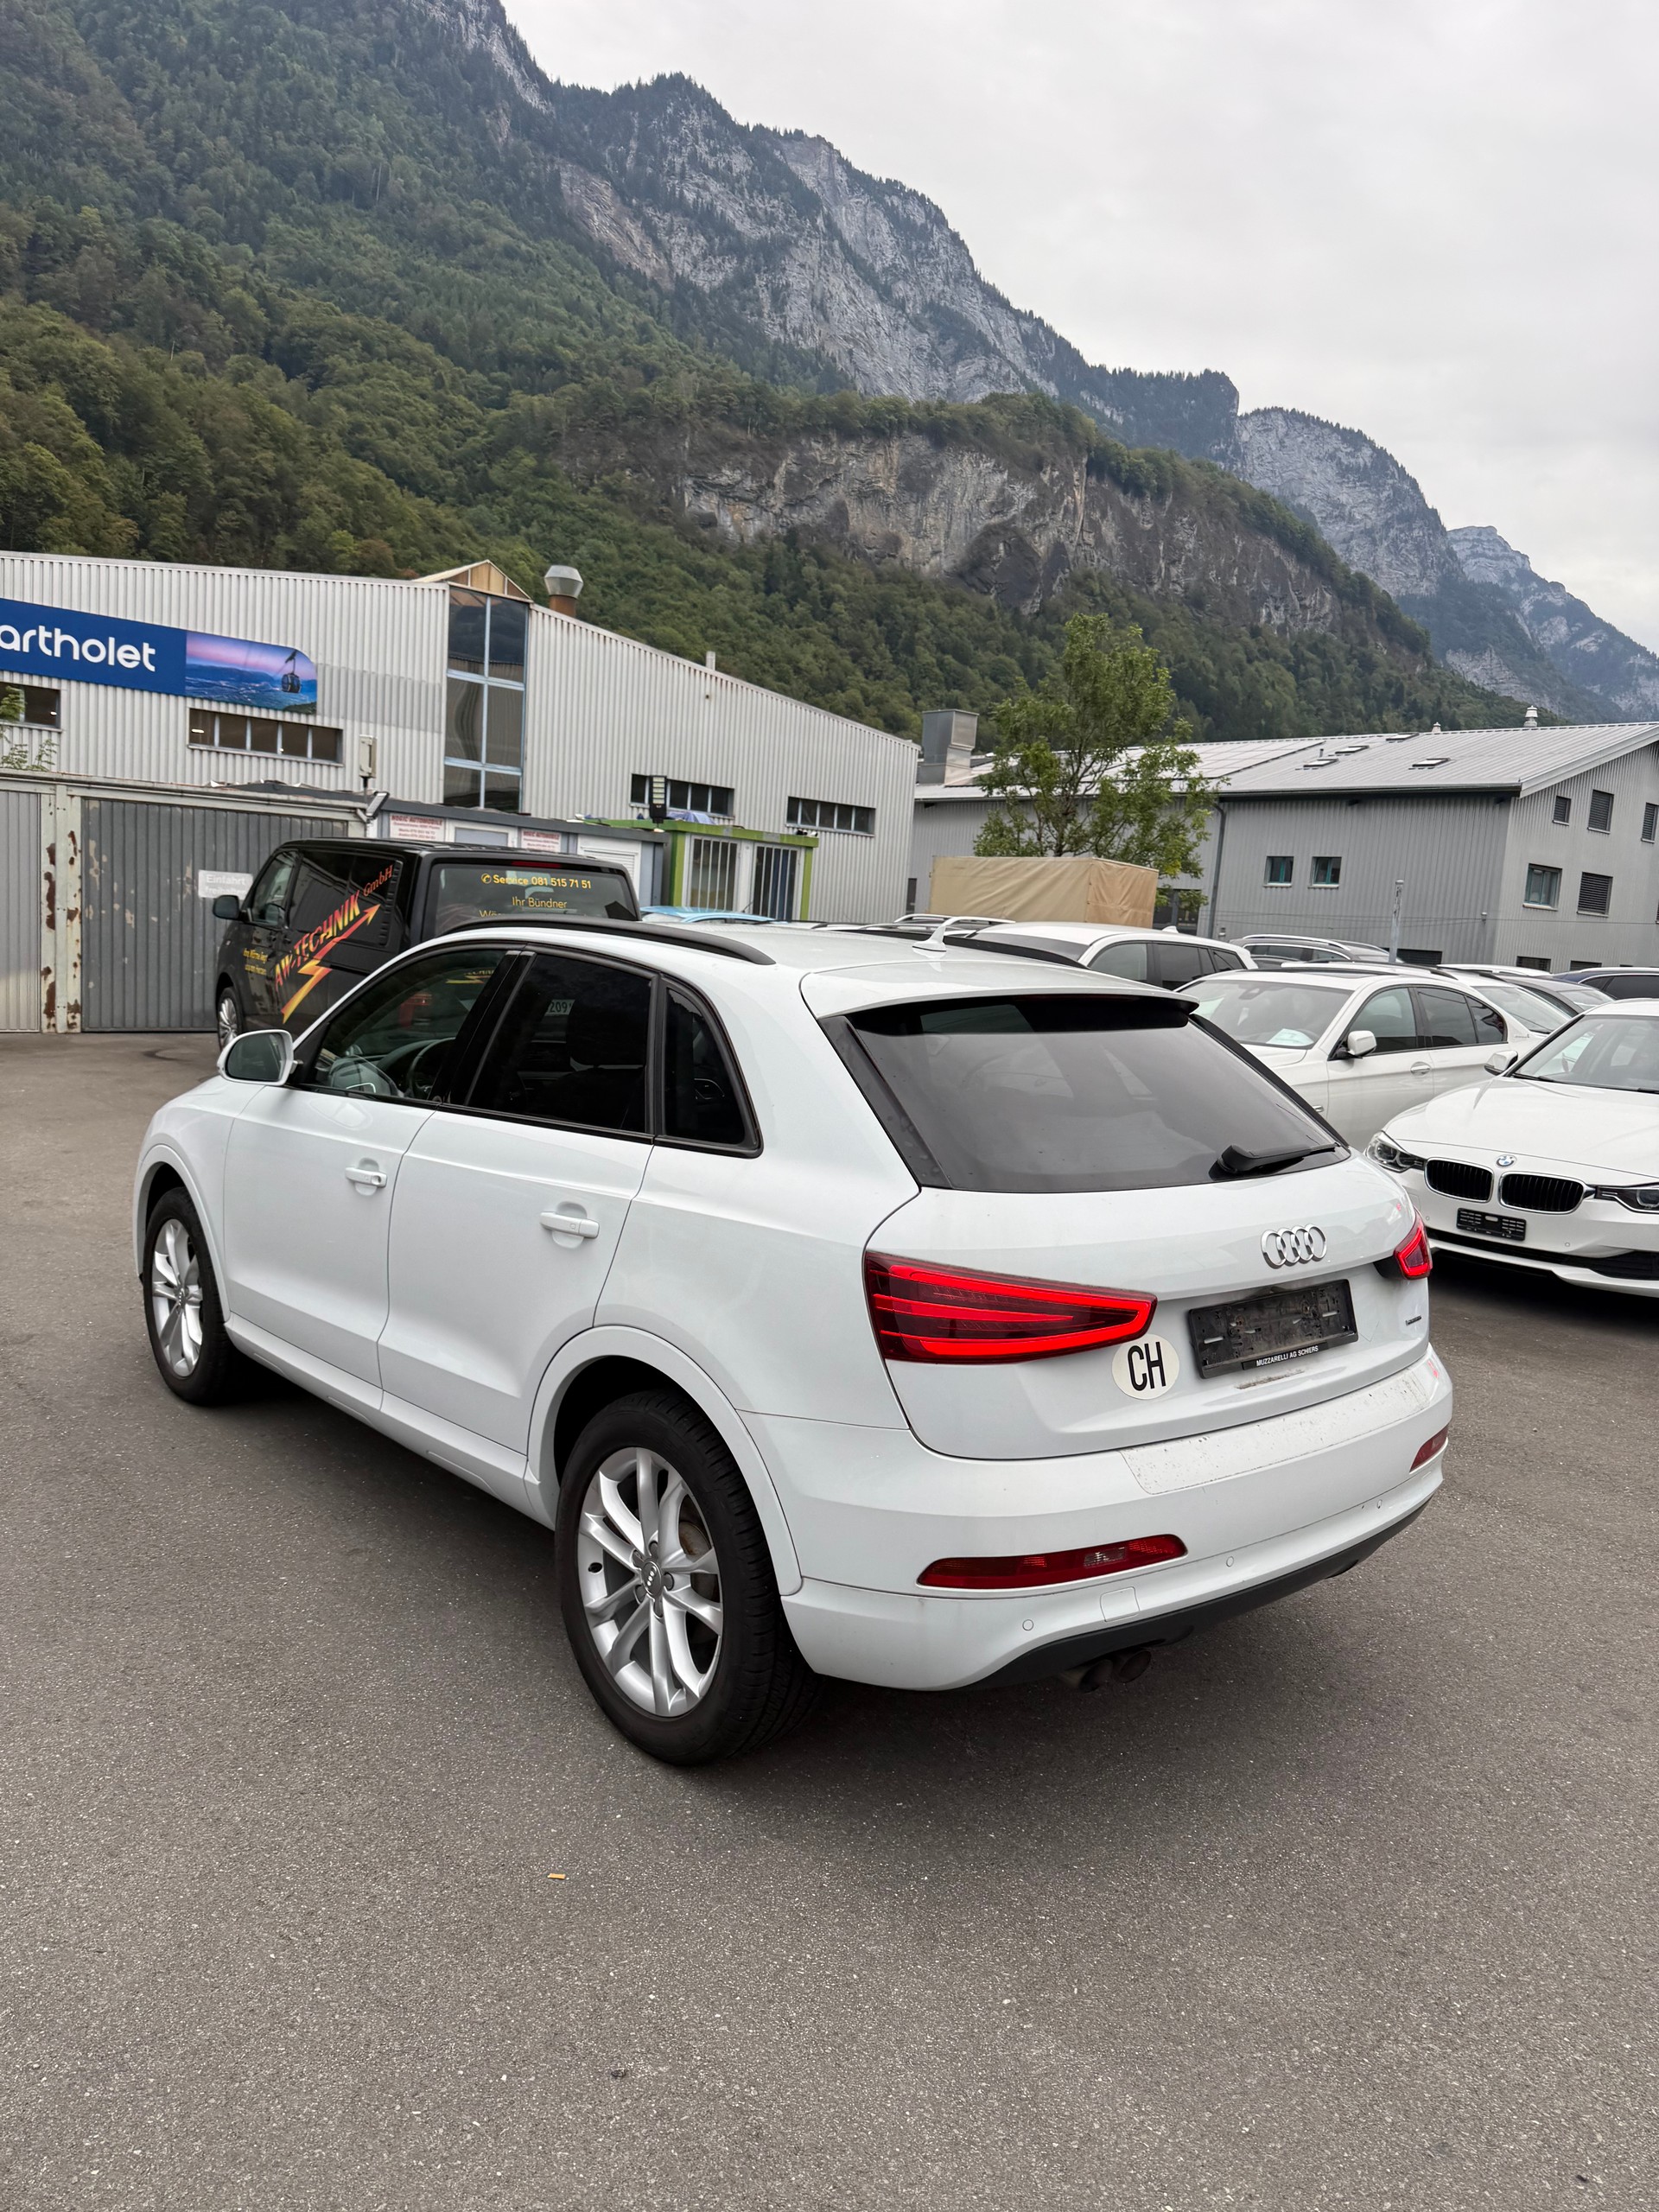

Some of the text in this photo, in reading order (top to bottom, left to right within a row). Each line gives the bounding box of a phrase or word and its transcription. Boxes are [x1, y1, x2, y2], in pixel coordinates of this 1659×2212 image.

[0, 625, 156, 671] artholet
[363, 865, 394, 897] GmbH
[493, 874, 591, 889] Service 081 515 71 51
[512, 896, 568, 908] Ihr Bündner
[550, 1001, 572, 1013] 209
[1128, 1341, 1166, 1391] CH
[1256, 1345, 1319, 1366] MUZZARELLI AG SCHIERS
